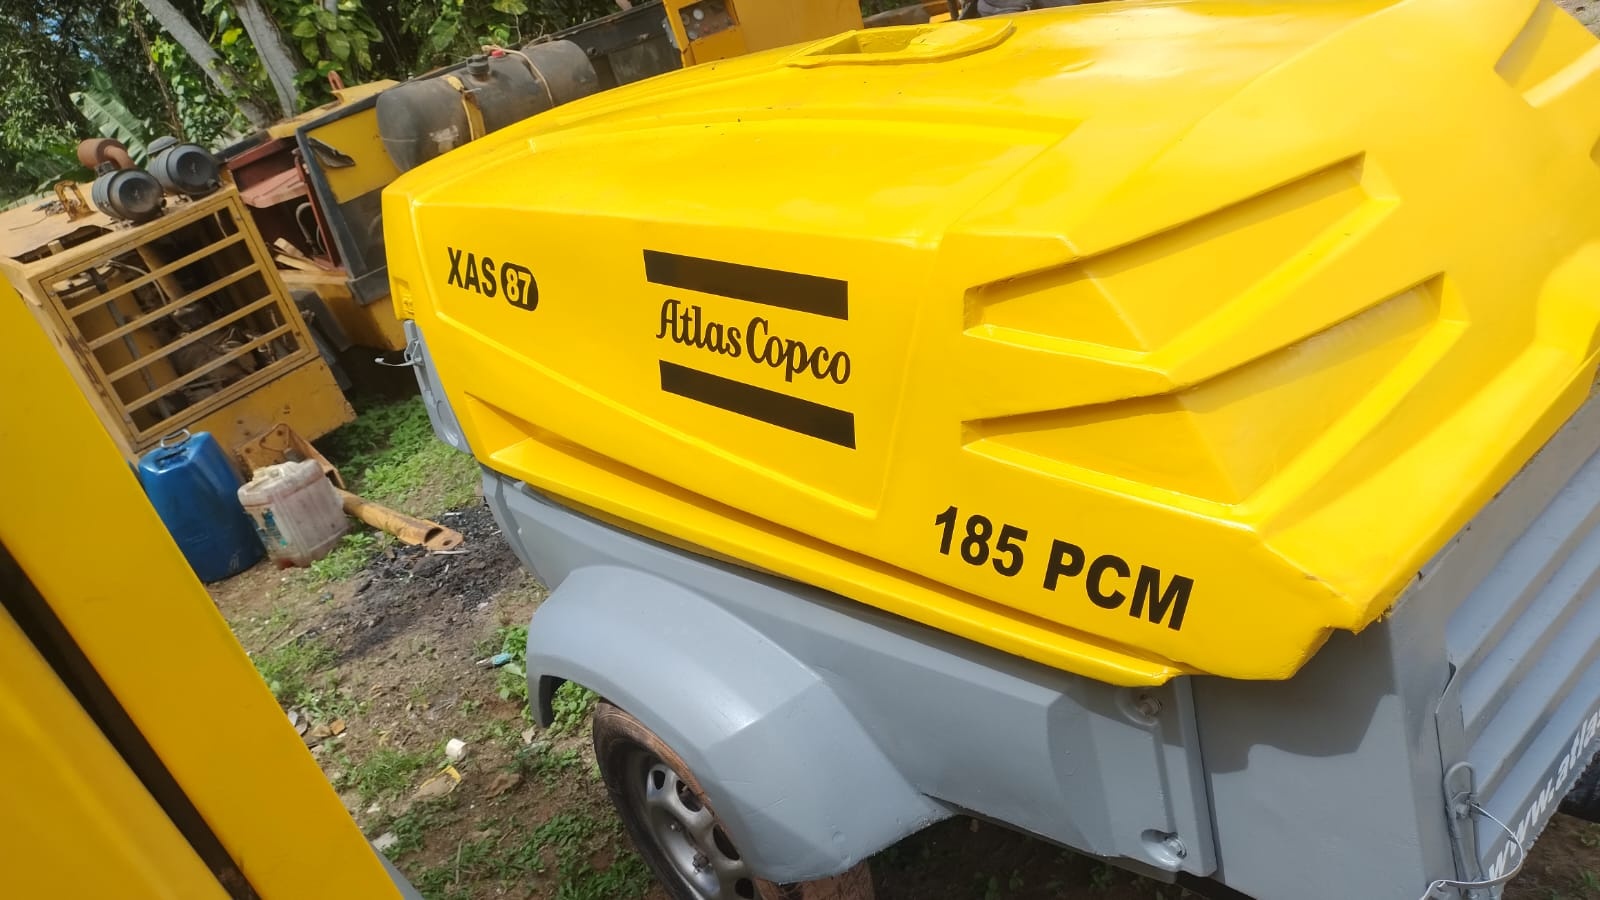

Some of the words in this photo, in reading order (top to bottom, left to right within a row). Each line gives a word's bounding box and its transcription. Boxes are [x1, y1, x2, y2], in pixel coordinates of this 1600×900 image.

[447, 246, 497, 298] XAS
[506, 268, 532, 305] 87
[655, 298, 742, 358] Atlas
[745, 316, 851, 385] Copco
[934, 505, 1028, 577] 185
[1043, 538, 1195, 631] PCM
[1488, 708, 1600, 881] www.atla
